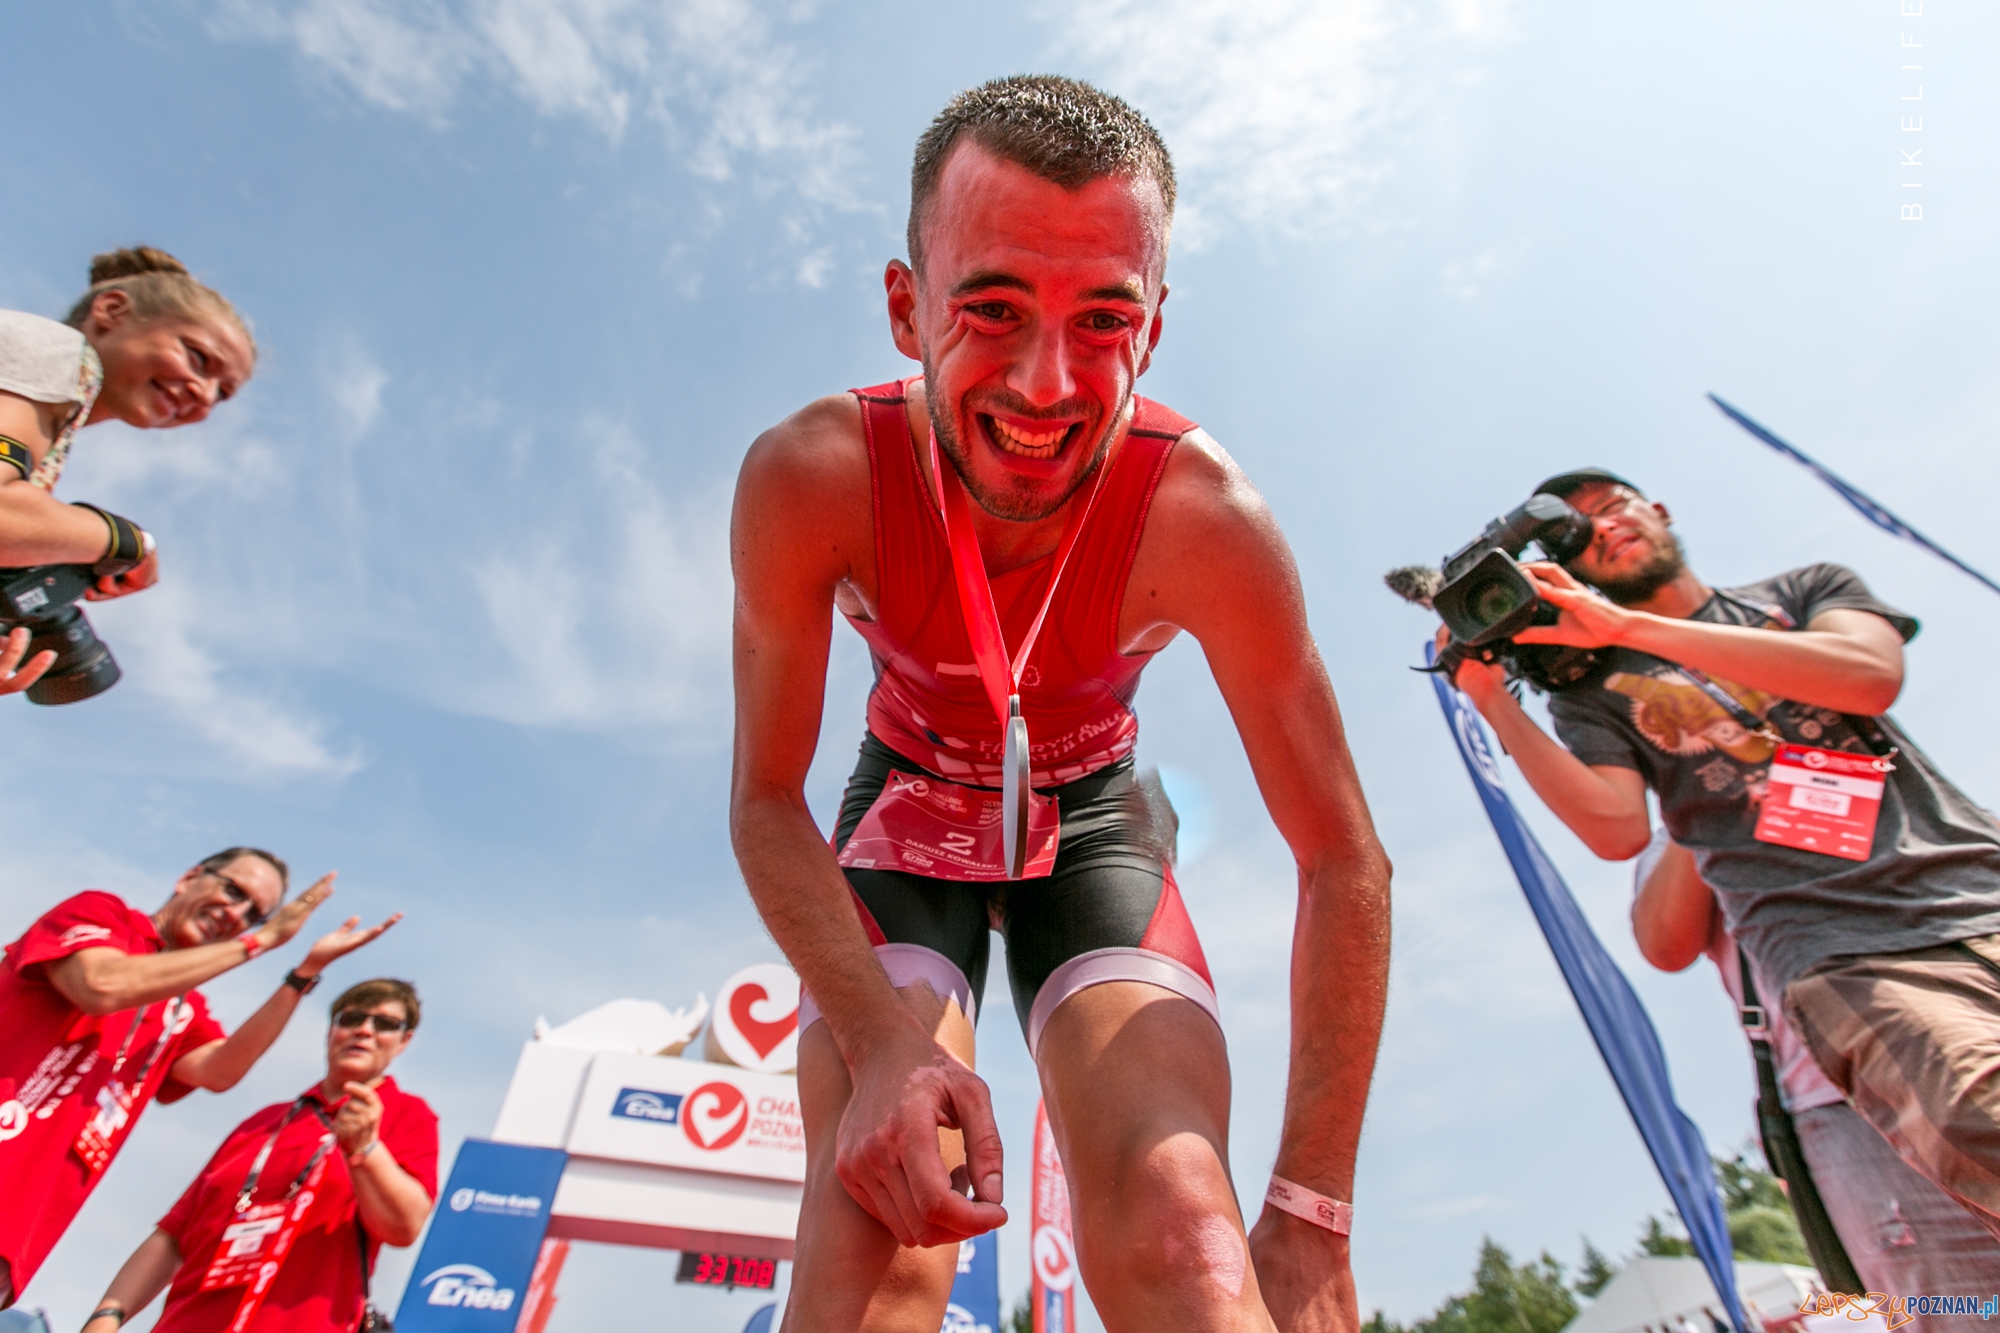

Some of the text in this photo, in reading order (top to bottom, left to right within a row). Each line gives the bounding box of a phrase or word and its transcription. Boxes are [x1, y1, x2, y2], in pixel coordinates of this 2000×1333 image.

[905, 838, 998, 869] DARIUSZ KOWALSKI
[939, 831, 976, 856] 2
[625, 1101, 676, 1121] Enea
[751, 1118, 805, 1138] POZNA
[427, 1277, 515, 1311] Enea
